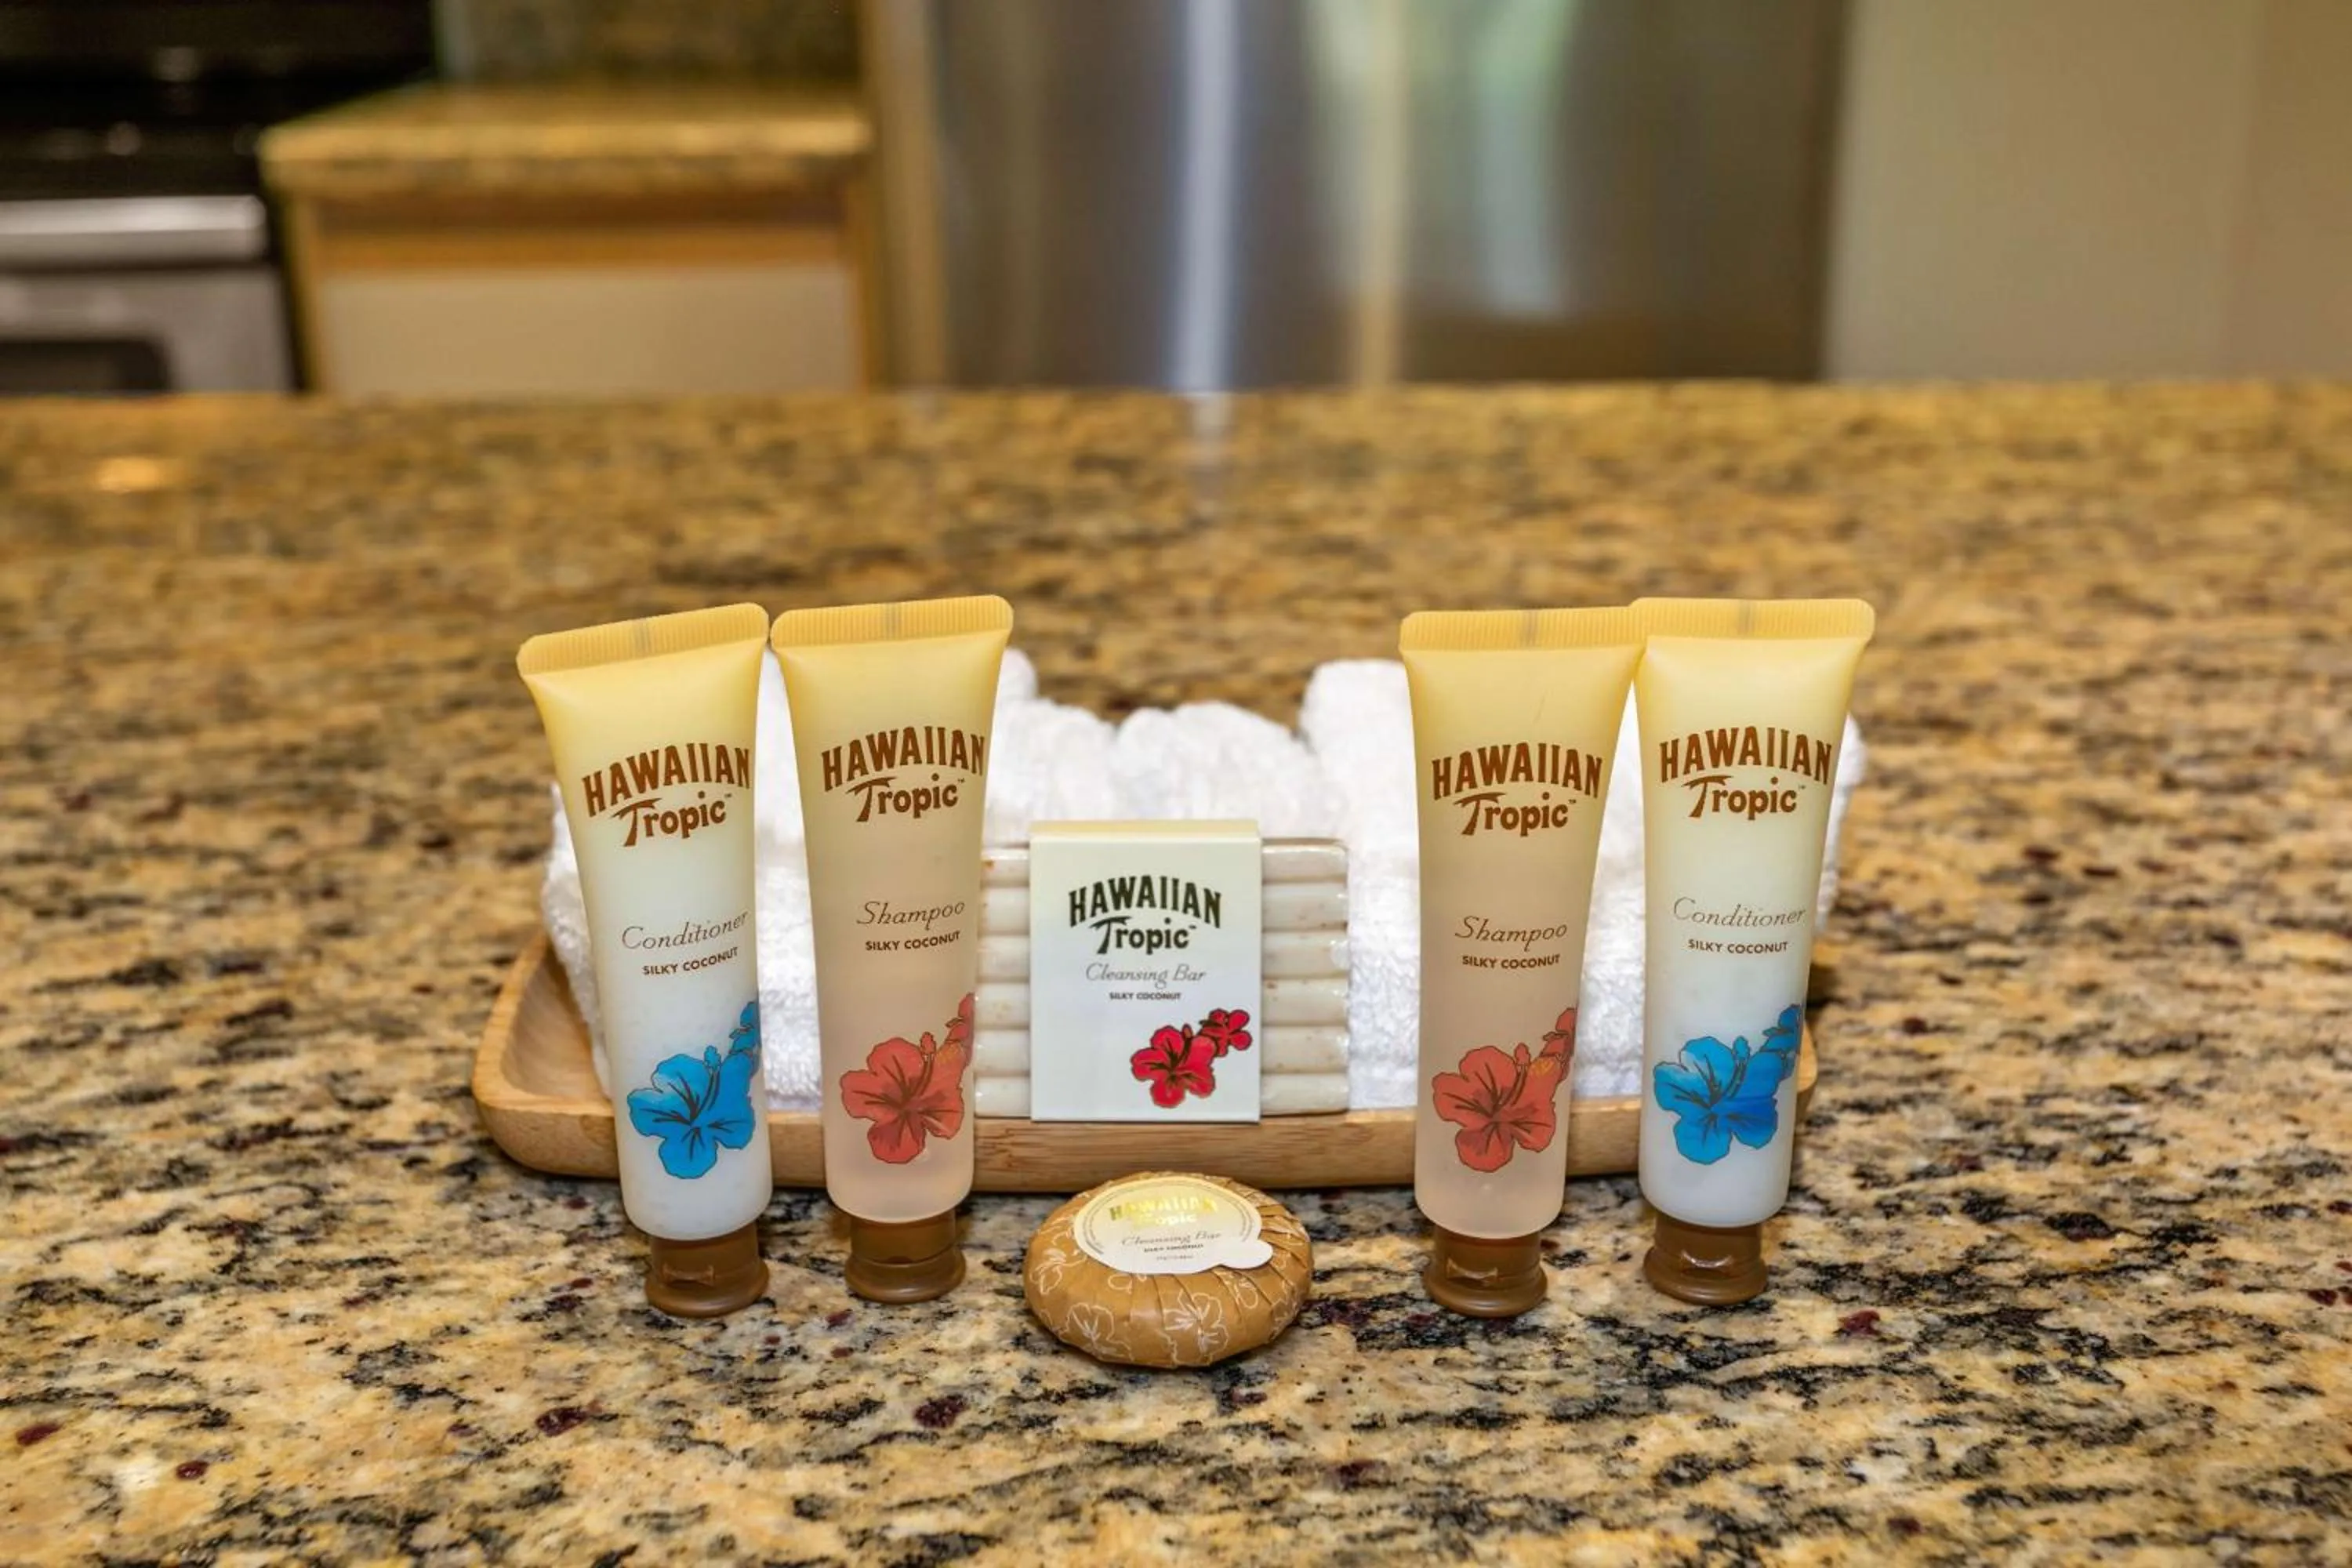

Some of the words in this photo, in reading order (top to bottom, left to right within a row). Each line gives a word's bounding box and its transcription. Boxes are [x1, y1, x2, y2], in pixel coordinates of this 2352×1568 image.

[821, 726, 985, 793] HAWAIIAN
[1432, 742, 1602, 800] HAWAIIAN
[1659, 726, 1832, 785] HAWAIIAN
[582, 742, 750, 817] HAWAIIAN
[845, 773, 959, 822] Tropic
[1682, 775, 1798, 820] Tropic
[609, 790, 727, 847] Tropic
[1453, 792, 1569, 837] Tropic
[856, 901, 965, 931] Shampoo
[1069, 875, 1221, 928] HAWAIIAN
[1673, 896, 1806, 927] Conditioner
[622, 911, 749, 950] Conditioner
[865, 940, 900, 951] SILKY
[904, 931, 960, 949] COCONUT
[1090, 916, 1190, 955] Tropic
[1455, 915, 1568, 953] Shampoo
[1688, 939, 1722, 952] SILKY
[1727, 941, 1788, 954] COCONUT
[642, 963, 678, 976] SILKY
[683, 946, 739, 971] COCONUT
[1085, 962, 1169, 989] Cleansing
[1173, 964, 1207, 982] Bar
[1462, 955, 1497, 968] SILKY
[1501, 953, 1561, 970] COCONUT
[1109, 992, 1134, 1000] SILKY
[1136, 992, 1182, 1000] COCONUT
